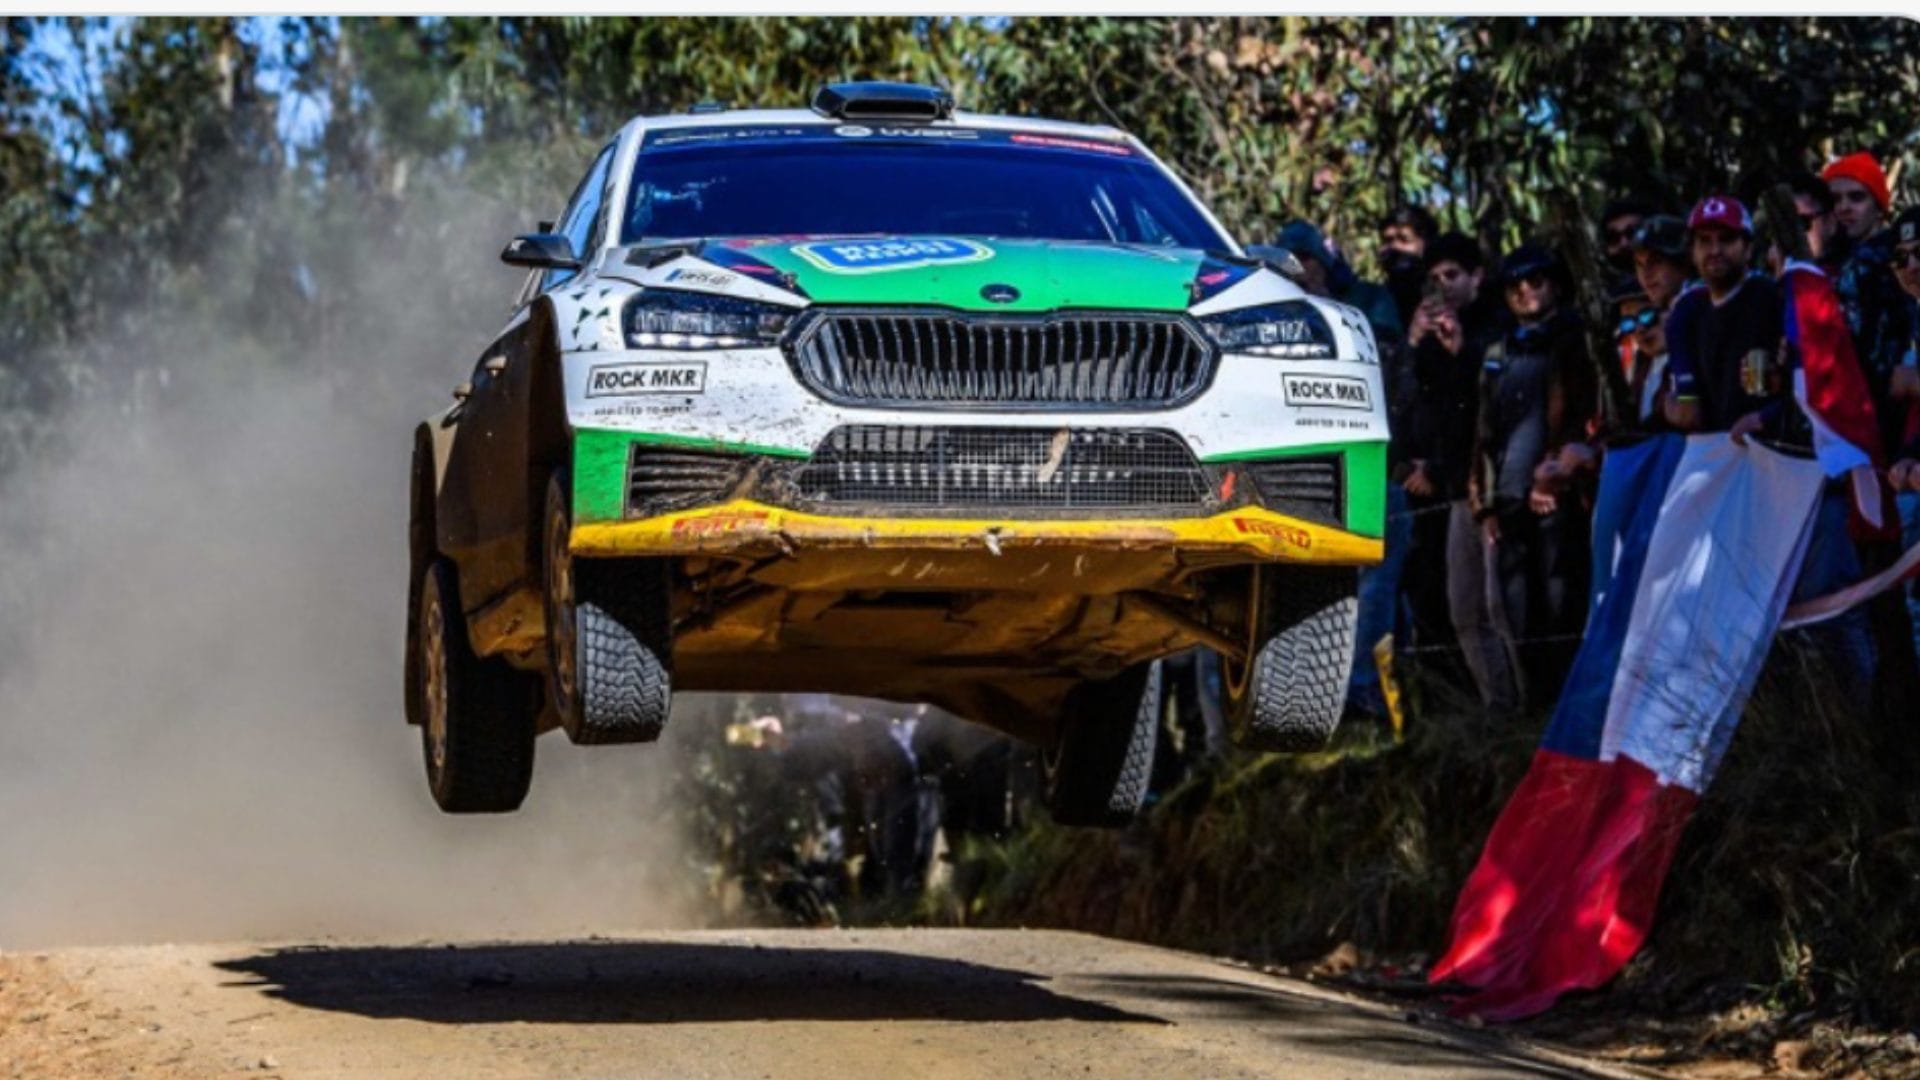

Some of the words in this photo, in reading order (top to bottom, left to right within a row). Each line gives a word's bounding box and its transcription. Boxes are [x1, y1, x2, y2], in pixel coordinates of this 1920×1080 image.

[594, 369, 647, 389] ROCK
[651, 369, 698, 387] MKR
[1290, 380, 1334, 399] ROCK
[1335, 383, 1366, 401] MKR
